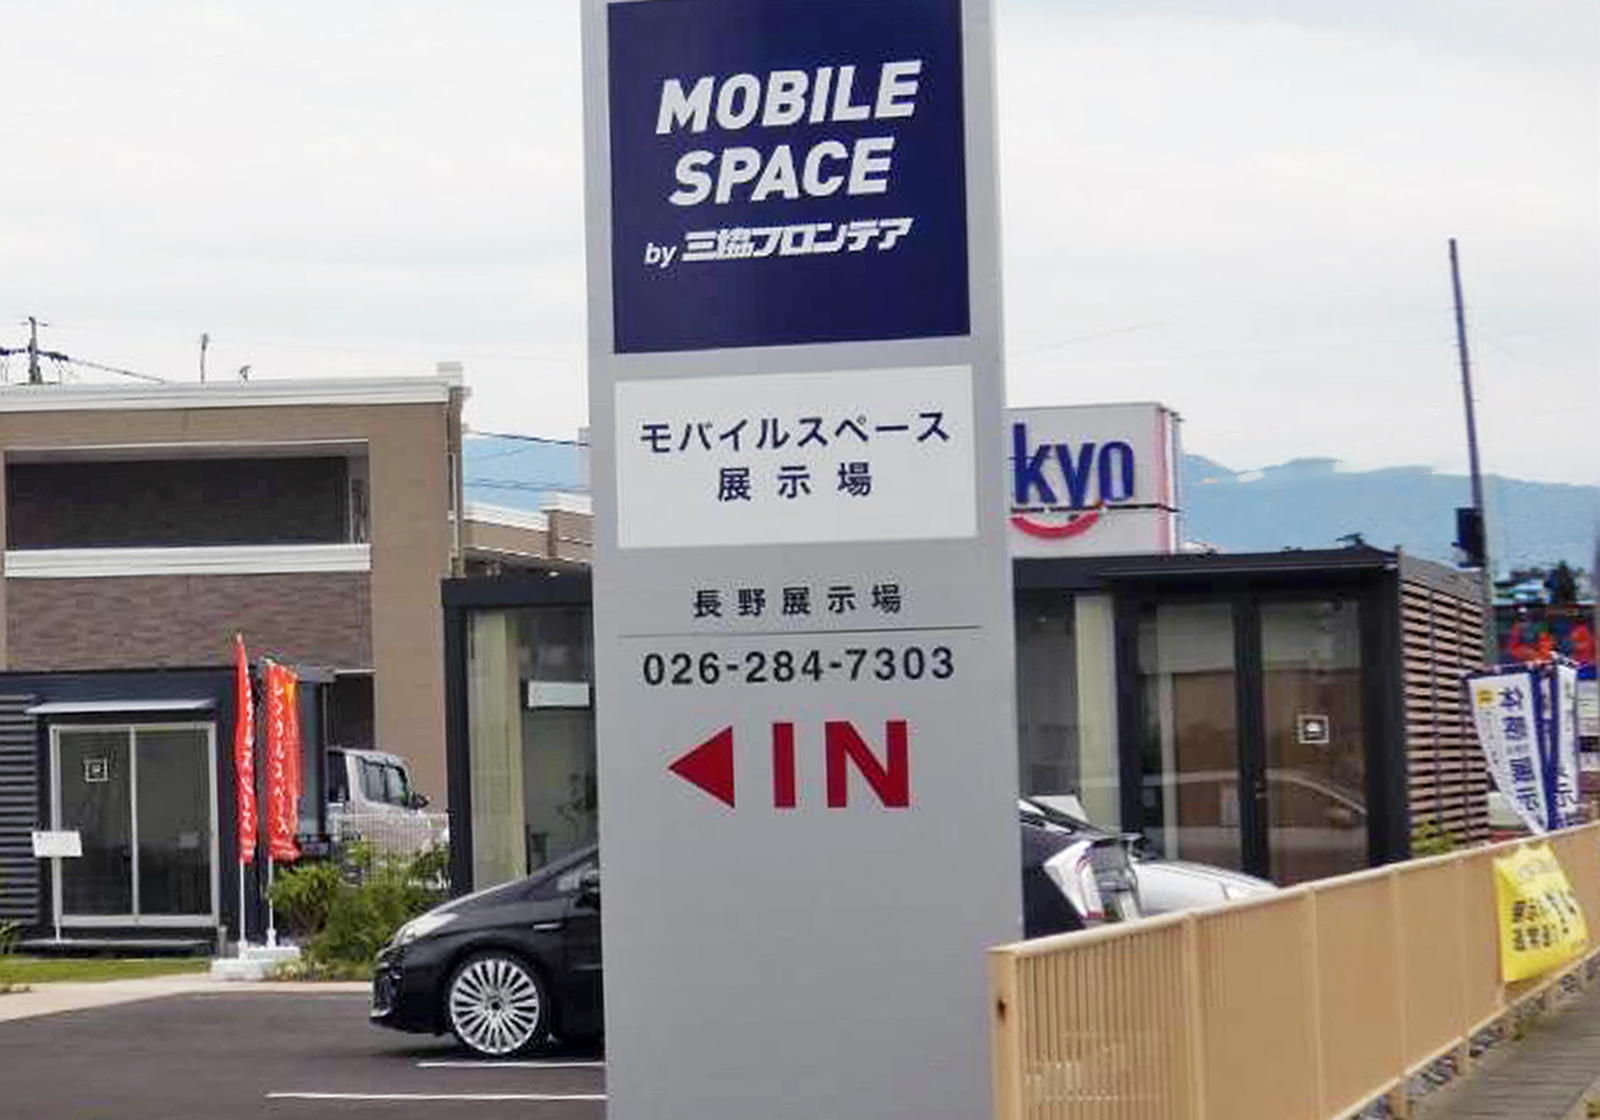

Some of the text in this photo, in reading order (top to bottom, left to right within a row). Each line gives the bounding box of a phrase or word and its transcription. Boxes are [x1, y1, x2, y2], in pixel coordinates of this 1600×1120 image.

[655, 59, 923, 135] MOBILE
[668, 136, 895, 207] SPACE
[644, 217, 913, 268] by 三協フロンテア
[639, 409, 950, 455] モバイルスペース
[717, 462, 873, 502] 展示場
[693, 584, 901, 618] 長野展示場
[643, 647, 955, 686] 026-284-7303
[772, 720, 910, 808] IN
